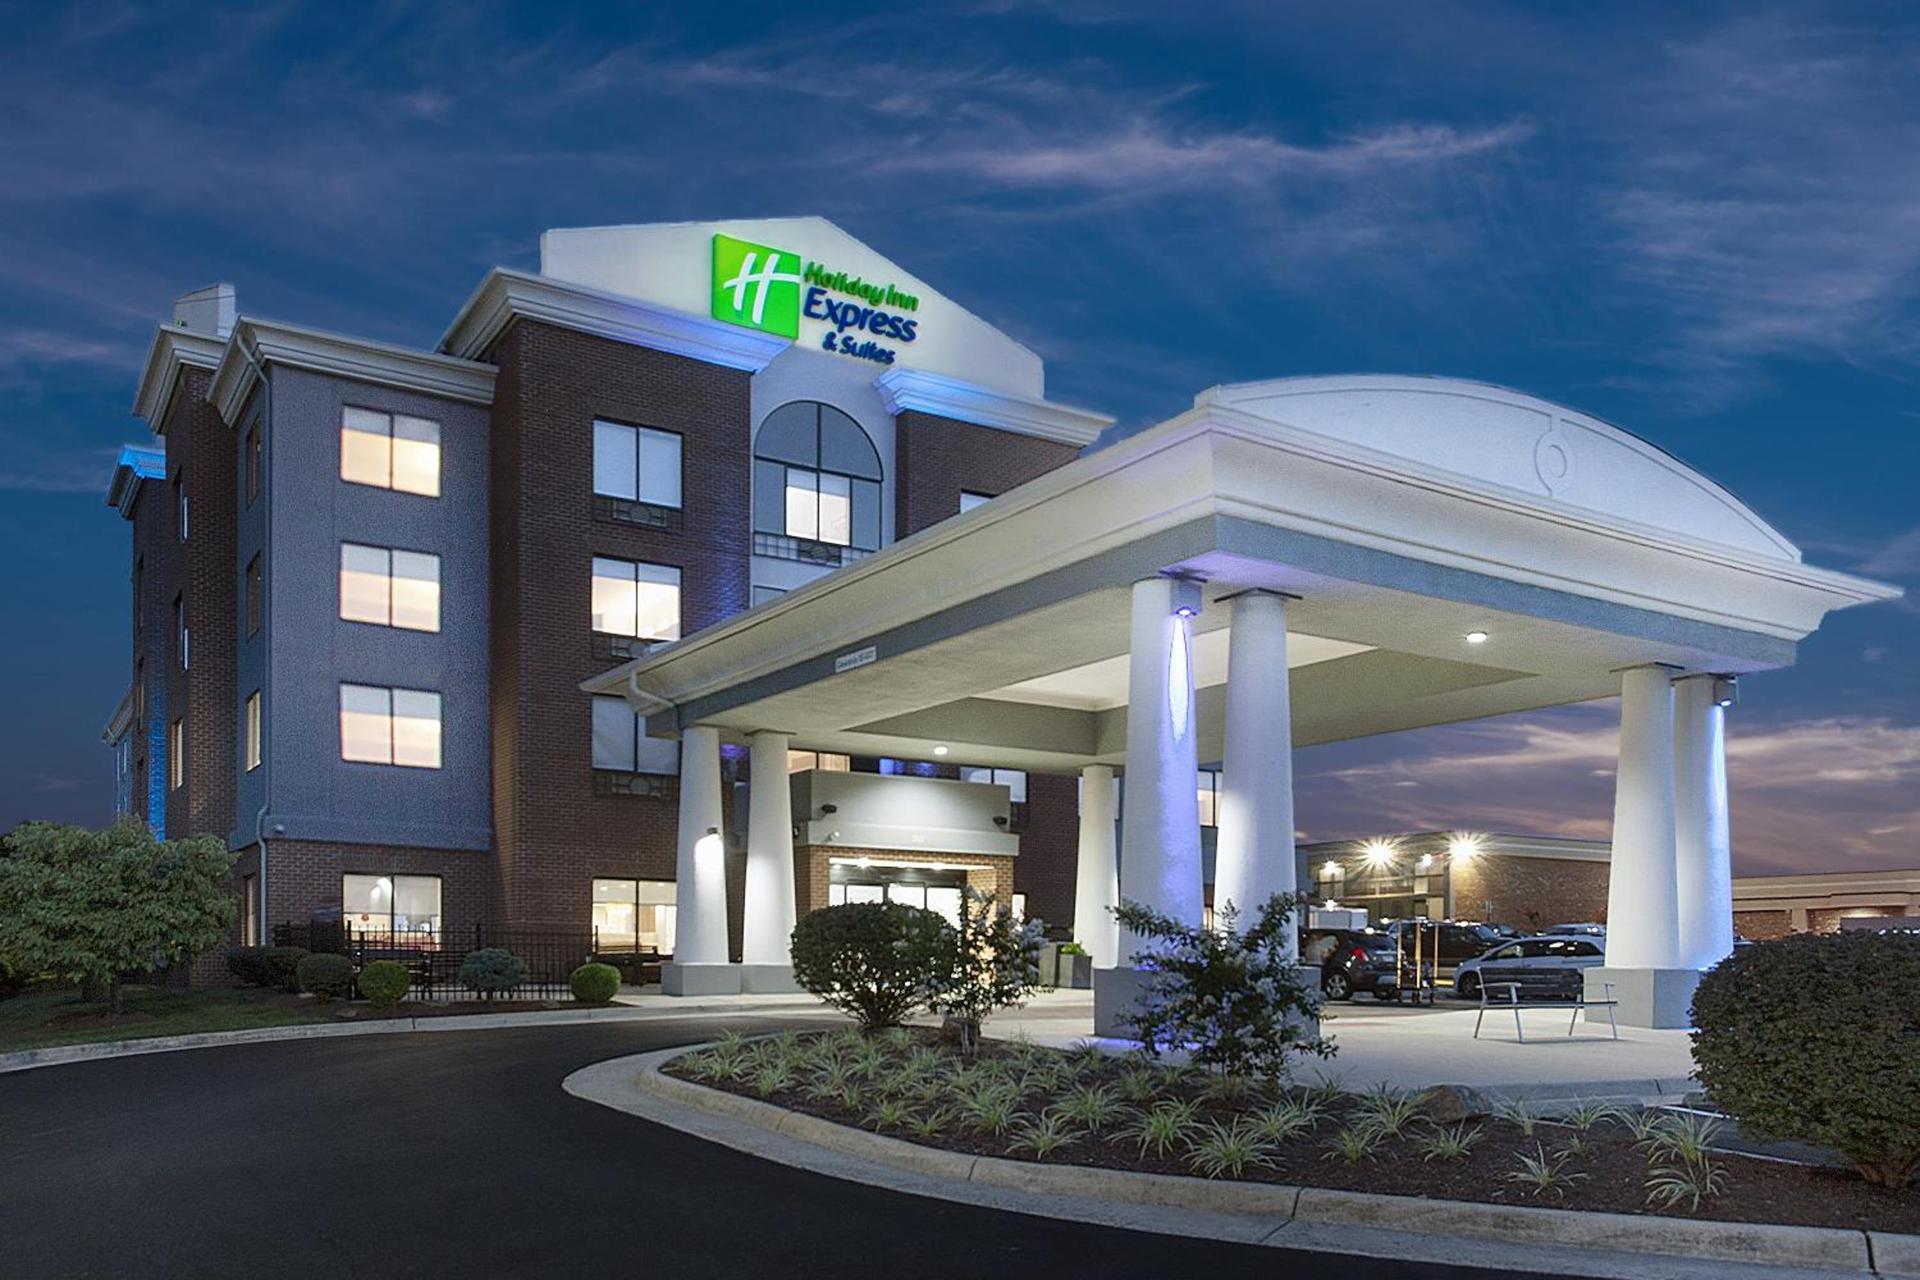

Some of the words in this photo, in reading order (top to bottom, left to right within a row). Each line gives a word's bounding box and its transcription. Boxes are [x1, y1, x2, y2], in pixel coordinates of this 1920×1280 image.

[723, 252, 800, 325] H
[804, 261, 886, 306] Holiday
[886, 284, 919, 311] Inn
[803, 287, 918, 342] Express
[822, 332, 838, 351] &
[839, 335, 896, 365] Suites
